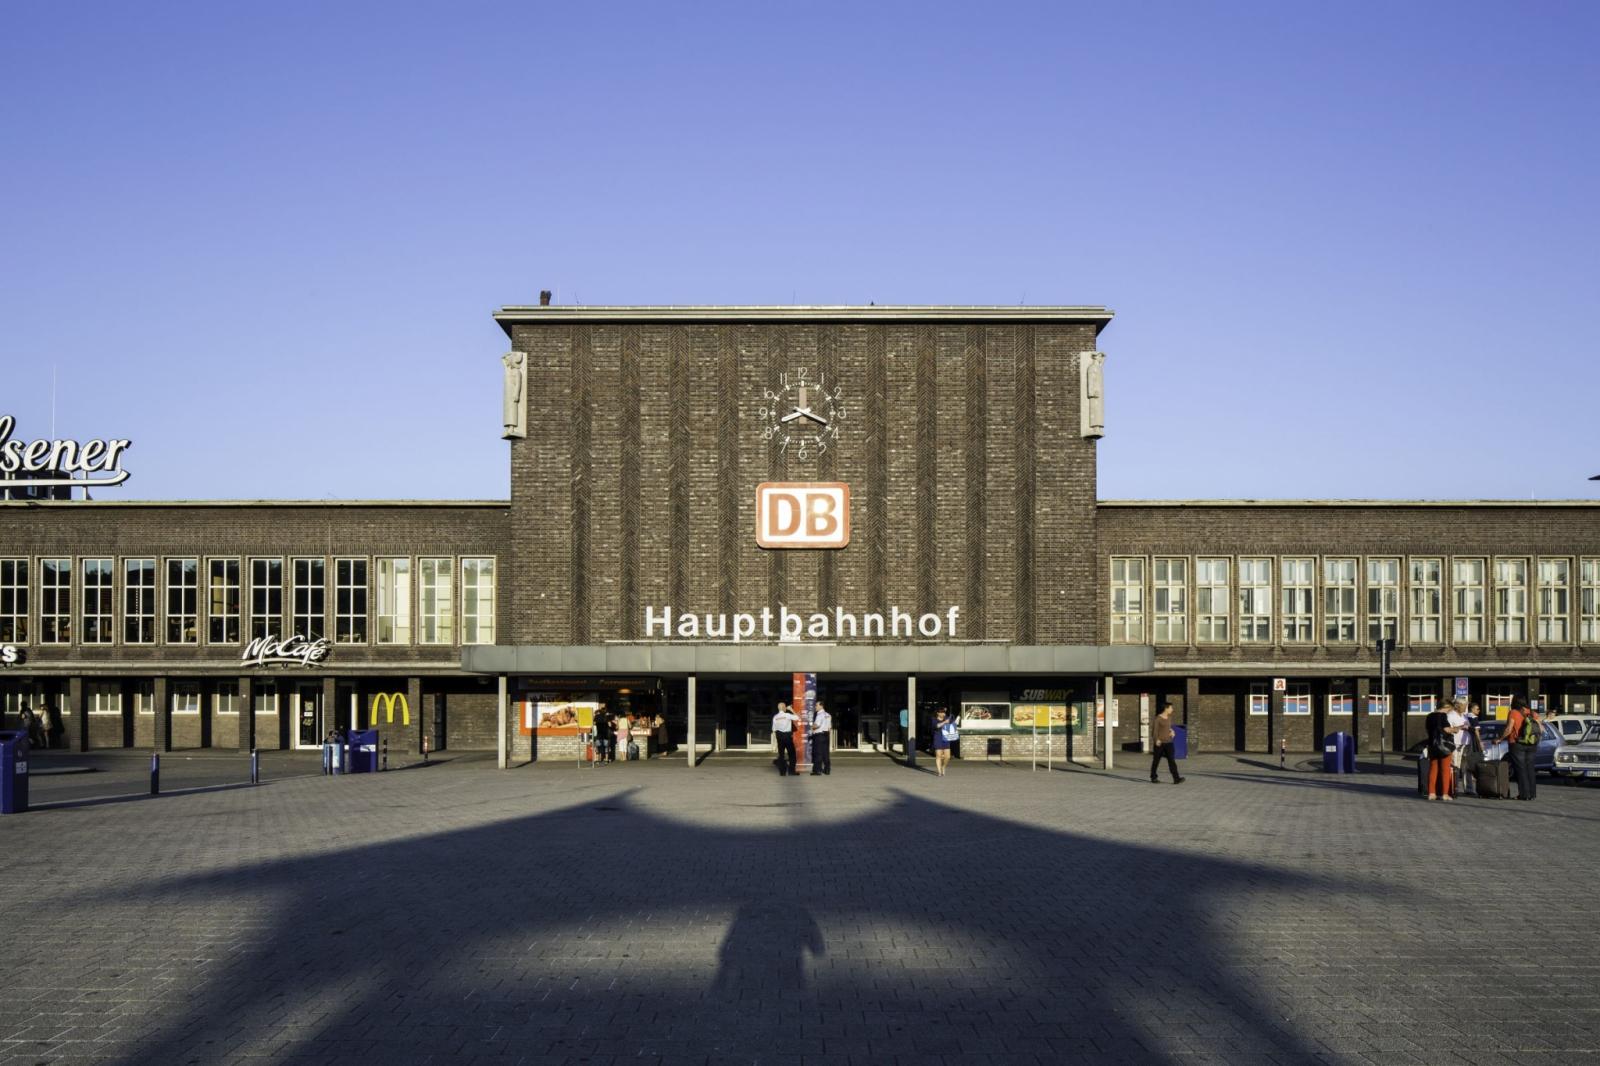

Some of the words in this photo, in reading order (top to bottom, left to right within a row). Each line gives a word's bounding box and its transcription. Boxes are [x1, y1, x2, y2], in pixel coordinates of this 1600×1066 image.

[780, 372, 788, 385] 11
[797, 367, 808, 379] 12
[833, 387, 842, 399] 2
[758, 407, 768, 420] 9
[838, 407, 847, 419] 3
[763, 427, 773, 440] 8
[831, 427, 839, 440] 4
[779, 441, 790, 454] 7
[798, 447, 808, 459] 6
[818, 441, 827, 456] 5
[768, 493, 838, 537] DB
[645, 605, 960, 643] Hauptbahnhof
[1019, 688, 1075, 701] SUBWAY
